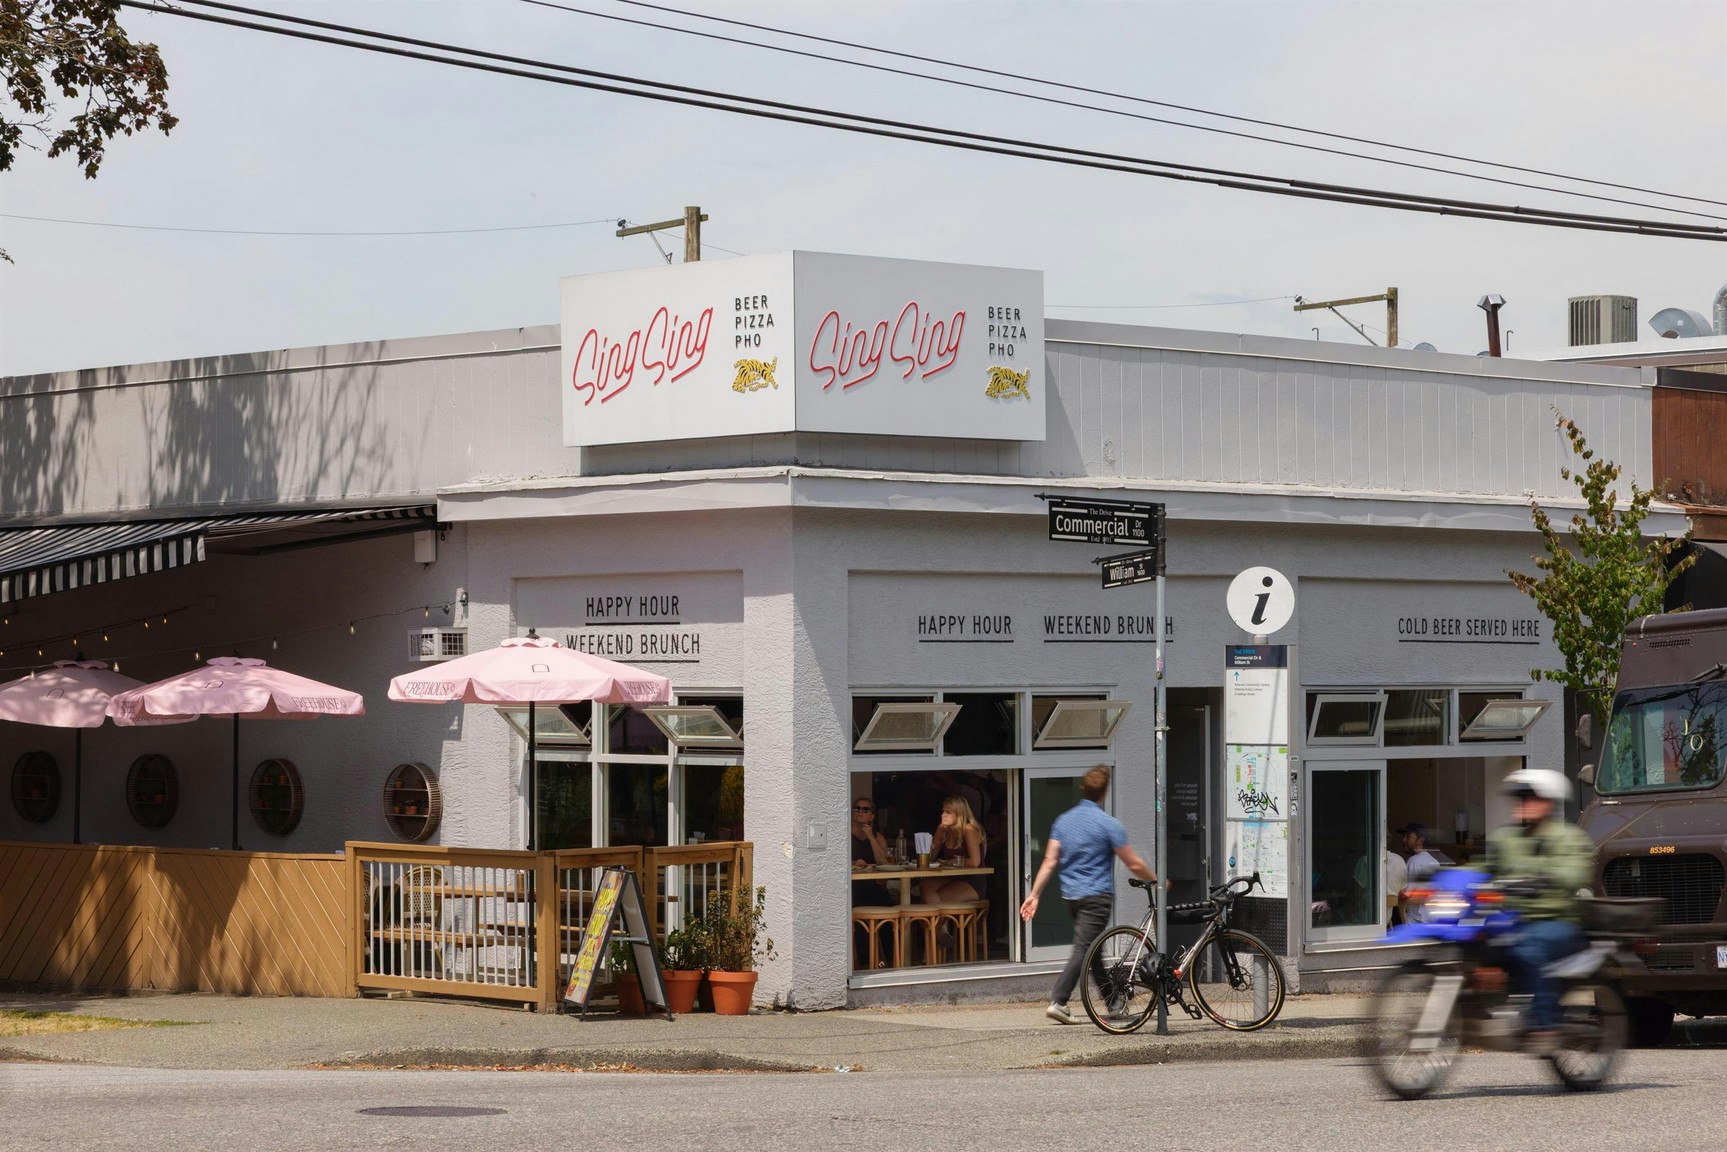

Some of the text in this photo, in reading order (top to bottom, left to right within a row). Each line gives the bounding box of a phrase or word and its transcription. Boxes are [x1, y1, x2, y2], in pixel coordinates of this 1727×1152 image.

[735, 295, 769, 311] BEER
[735, 313, 775, 329] PIZZA
[988, 306, 1021, 321] BEER
[988, 324, 1027, 340] PIZZA
[735, 333, 762, 348] PHO
[810, 300, 966, 391] Sing Sing
[573, 306, 714, 406] Sing Sing
[988, 343, 1015, 357] PHO
[1055, 515, 1129, 536] Commercial
[1135, 519, 1142, 528] Dr
[1132, 528, 1145, 537] 1100
[1110, 565, 1134, 581] William
[586, 595, 680, 617] HAPPY HOUR
[918, 615, 1012, 634] HAPPY HOUR
[1044, 615, 1173, 634] WEEKEND BRUNH
[1398, 617, 1540, 637] COLD BEER SERVED HERE
[566, 633, 700, 655] WEEKEND BRUNCH
